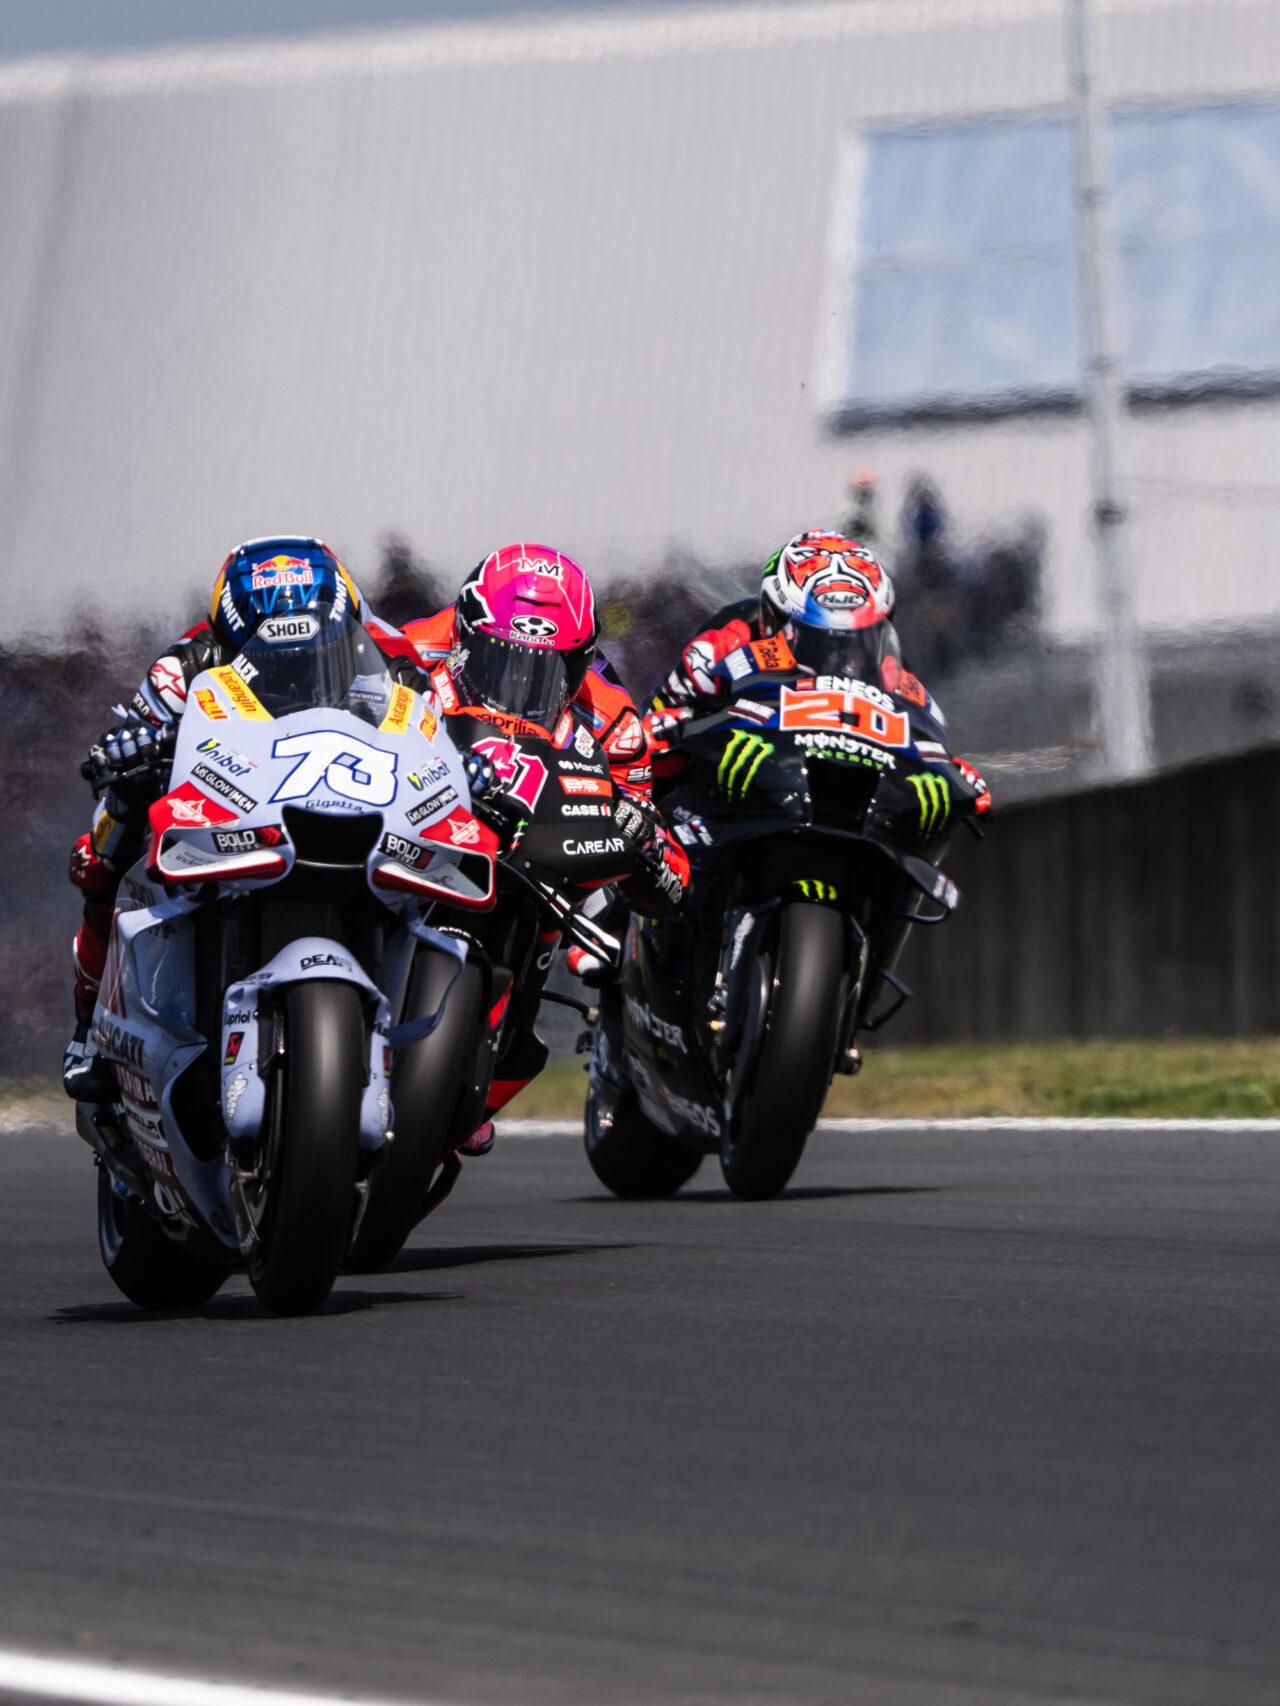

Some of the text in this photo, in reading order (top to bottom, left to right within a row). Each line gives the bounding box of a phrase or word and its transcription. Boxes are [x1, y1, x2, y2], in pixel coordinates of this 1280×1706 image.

[252, 570, 314, 590] Red Bull
[822, 593, 861, 605] HJC
[266, 621, 311, 638] SHOEI
[230, 653, 259, 684] ALEX
[816, 675, 896, 711] ENEOS
[475, 711, 539, 736] aprilia
[779, 684, 910, 748] 20
[196, 738, 253, 777] Unibat
[794, 732, 897, 770] MONSTER
[266, 729, 399, 808] 73
[407, 760, 451, 791] Unibat
[206, 774, 233, 795] GLOW
[561, 804, 599, 816] CASE
[216, 830, 257, 847] BOLD
[387, 834, 420, 860] BOLD
